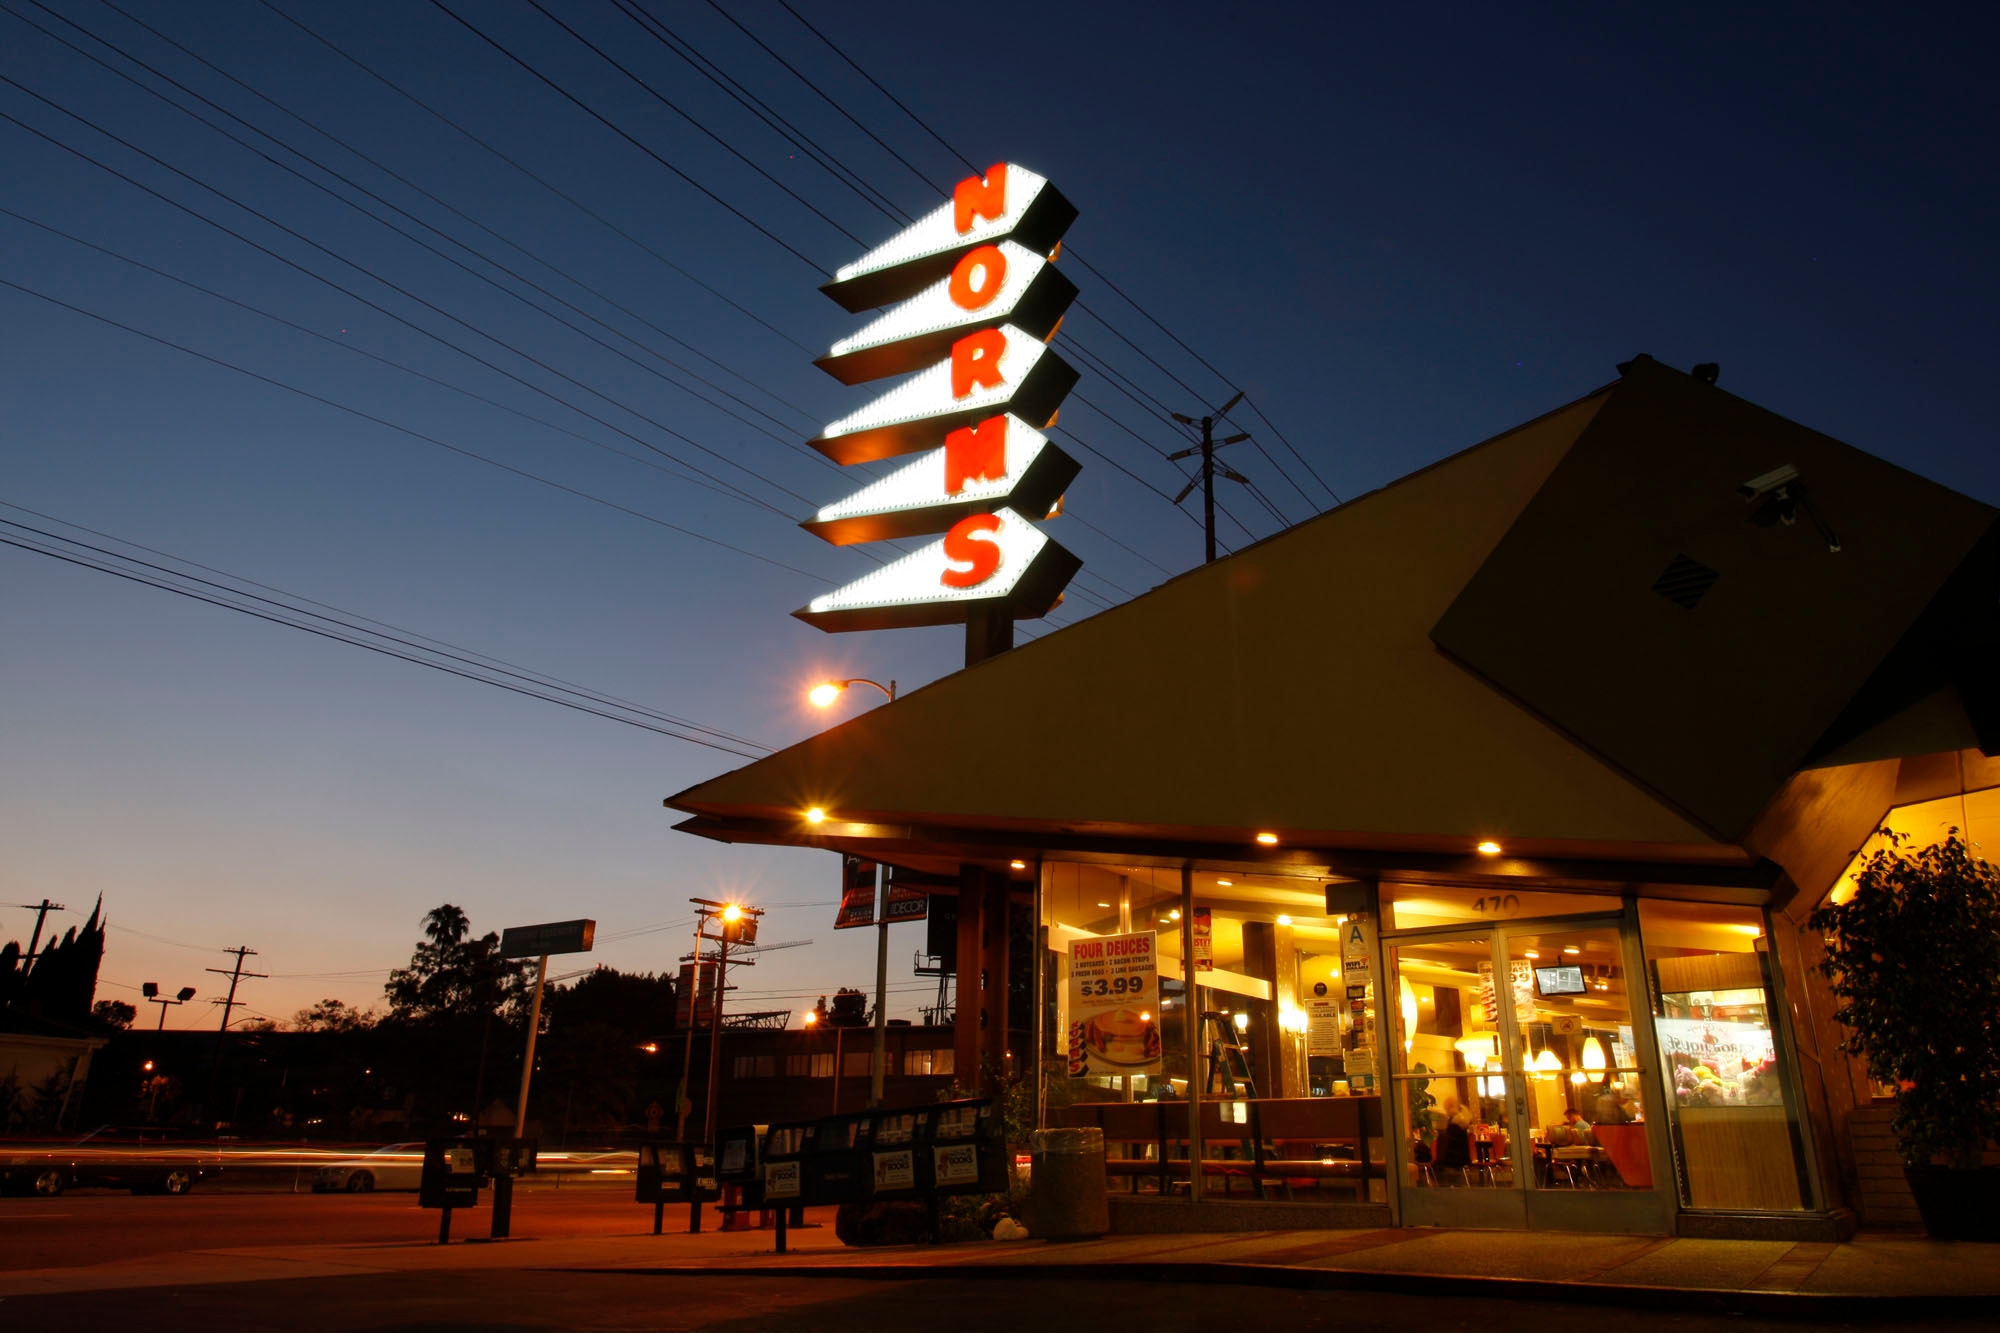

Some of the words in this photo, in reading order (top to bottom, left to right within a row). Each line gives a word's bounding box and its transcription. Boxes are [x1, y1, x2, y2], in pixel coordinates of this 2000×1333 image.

[941, 161, 1010, 589] NORMS
[1471, 894, 1520, 915] 470
[1350, 925, 1364, 943] A
[1074, 942, 1103, 960] FOUR
[1106, 937, 1150, 957] DEUCES
[1132, 955, 1150, 963] STRIPS
[1081, 976, 1144, 997] $3.99
